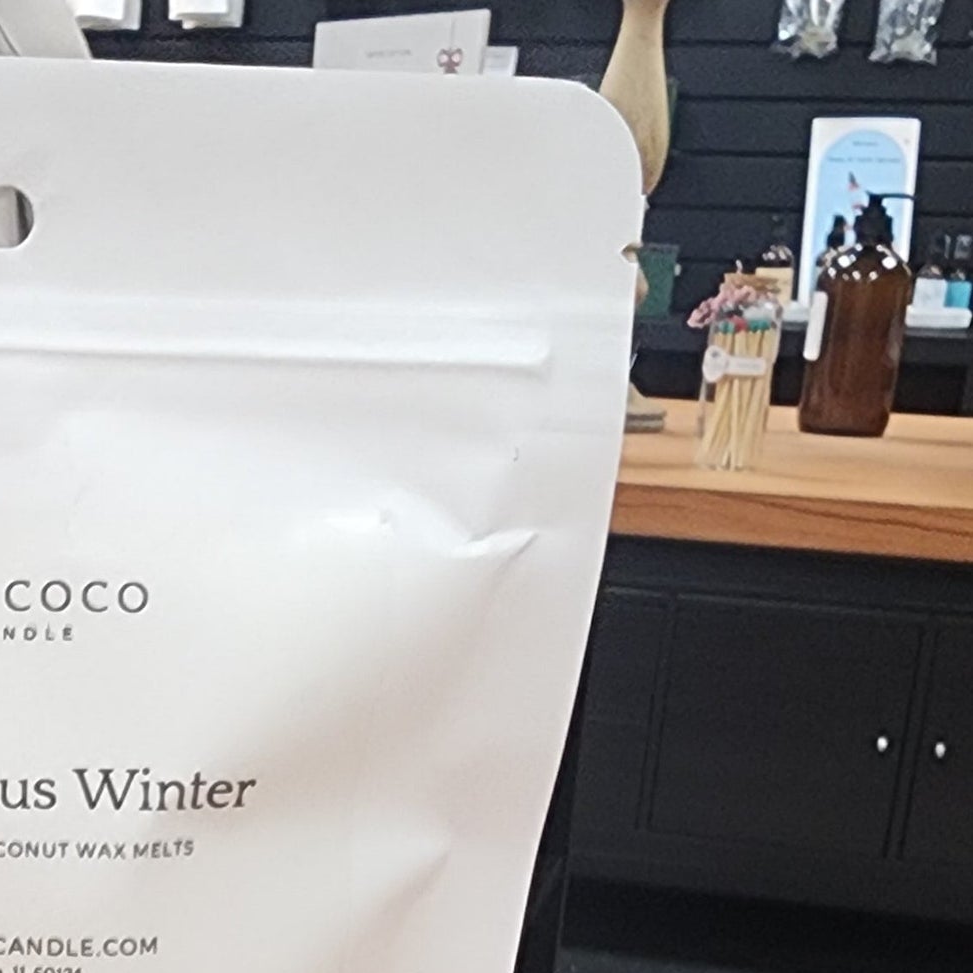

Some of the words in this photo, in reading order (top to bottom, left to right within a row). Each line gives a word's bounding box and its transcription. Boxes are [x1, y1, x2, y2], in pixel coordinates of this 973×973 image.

[4, 578, 150, 614] COCO
[71, 766, 258, 812] Winter
[75, 841, 128, 861] WAX
[132, 837, 197, 860] MELTS
